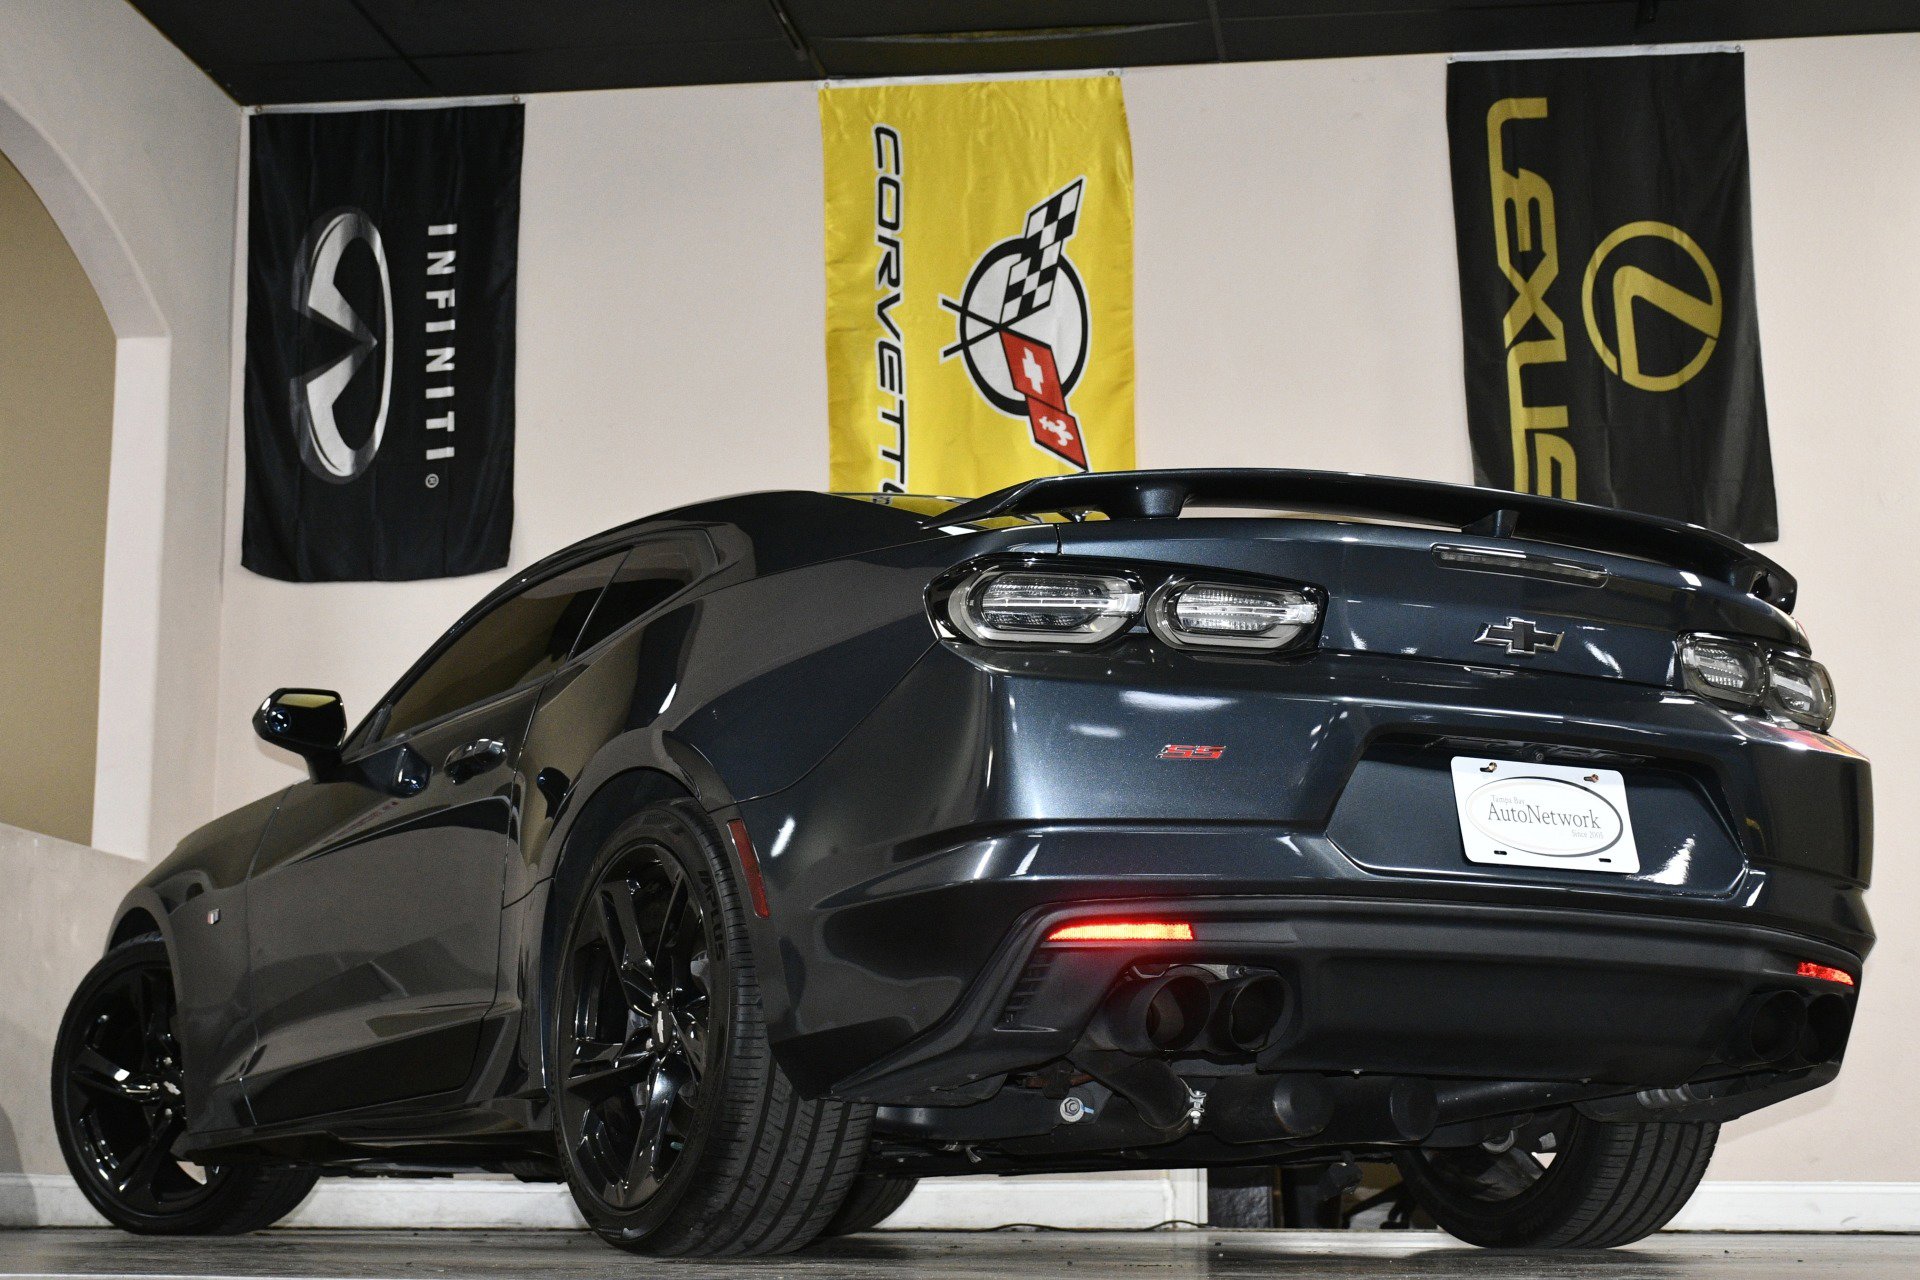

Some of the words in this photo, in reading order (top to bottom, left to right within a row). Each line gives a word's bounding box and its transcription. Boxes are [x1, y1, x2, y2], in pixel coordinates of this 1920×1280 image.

[425, 222, 458, 461] INFINITI
[1156, 744, 1226, 759] SS
[1488, 801, 1602, 829] AutoNetwork
